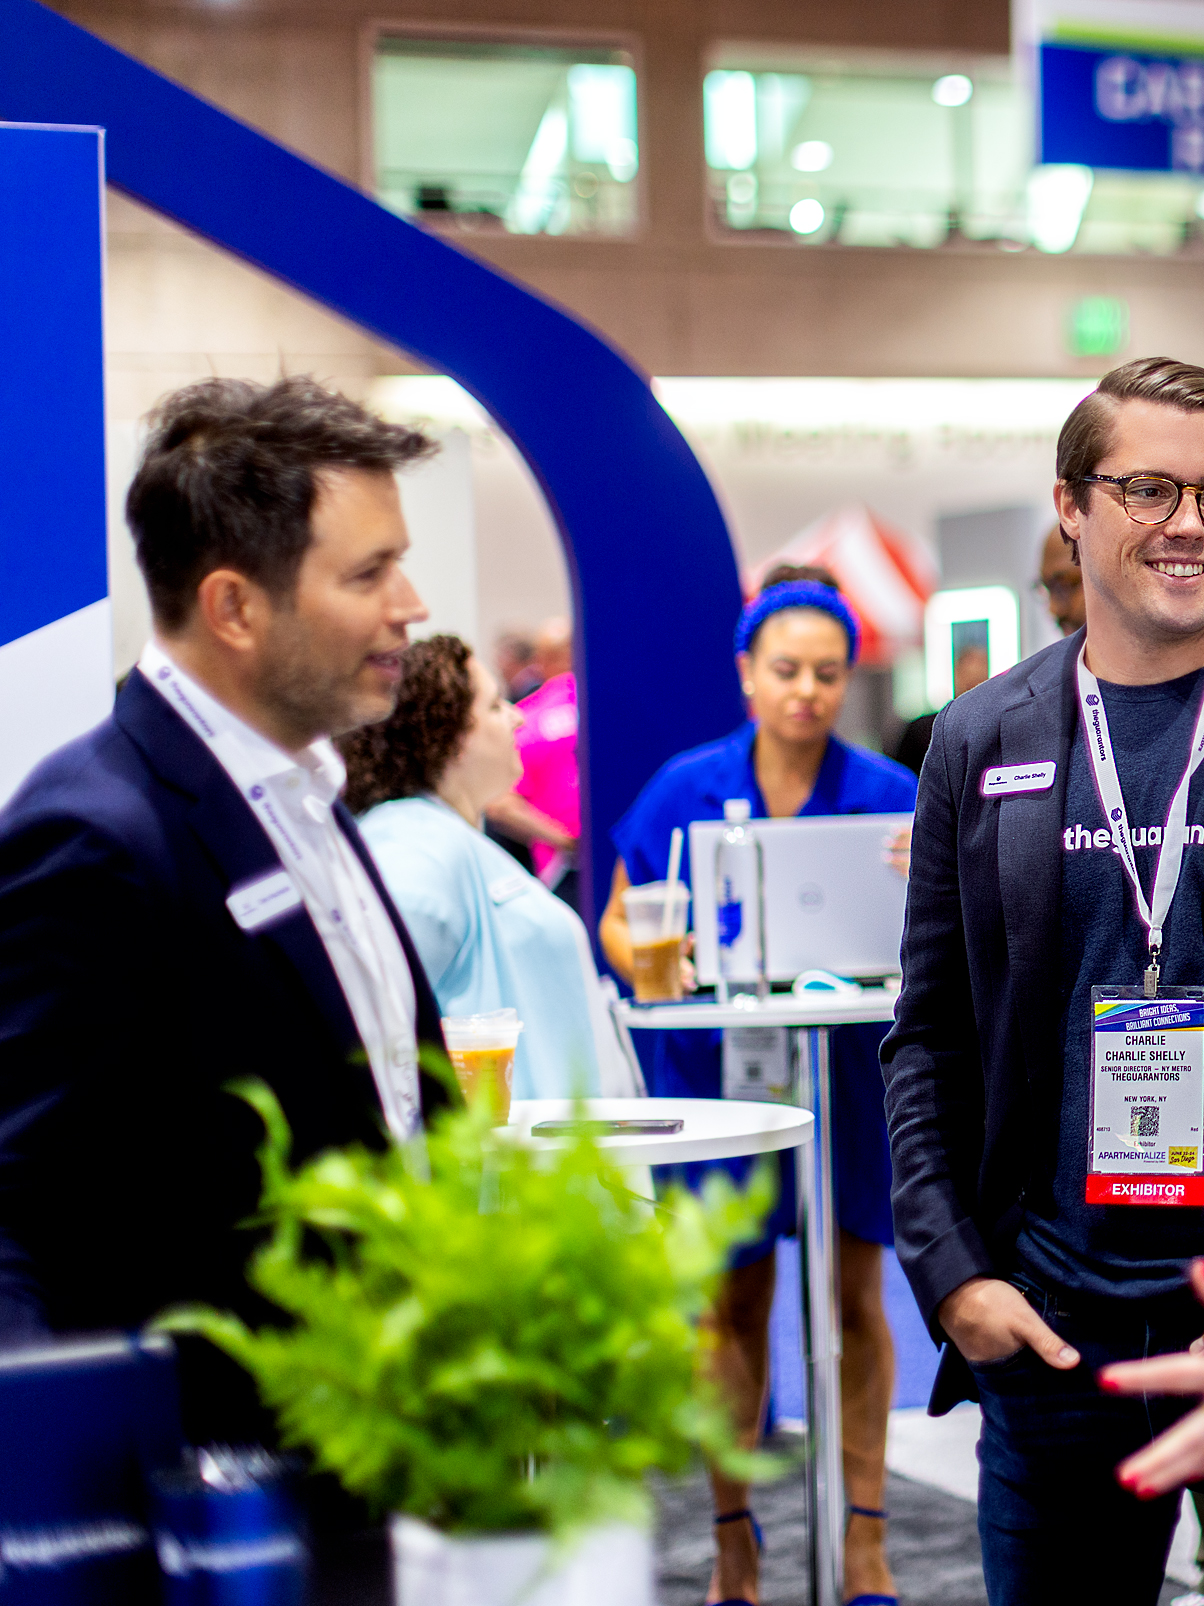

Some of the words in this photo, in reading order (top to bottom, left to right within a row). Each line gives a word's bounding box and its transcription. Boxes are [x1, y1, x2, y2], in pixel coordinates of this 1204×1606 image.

[1092, 709, 1106, 761] theguarantors
[1139, 1006, 1159, 1017] BRIGHT
[1126, 1018, 1152, 1030] BRILLIANT
[1153, 1013, 1190, 1026] CONNECTIONS
[1125, 1035, 1166, 1046] CHARLIE
[1105, 1051, 1146, 1061] CHARLIE
[1149, 1051, 1186, 1061] SHELLY
[1111, 1073, 1180, 1081] THEGUARANTORS
[1098, 1151, 1166, 1159] APARTMENTALIZE
[1170, 1156, 1180, 1164] San
[1112, 1183, 1185, 1196] EXHIBITOR
